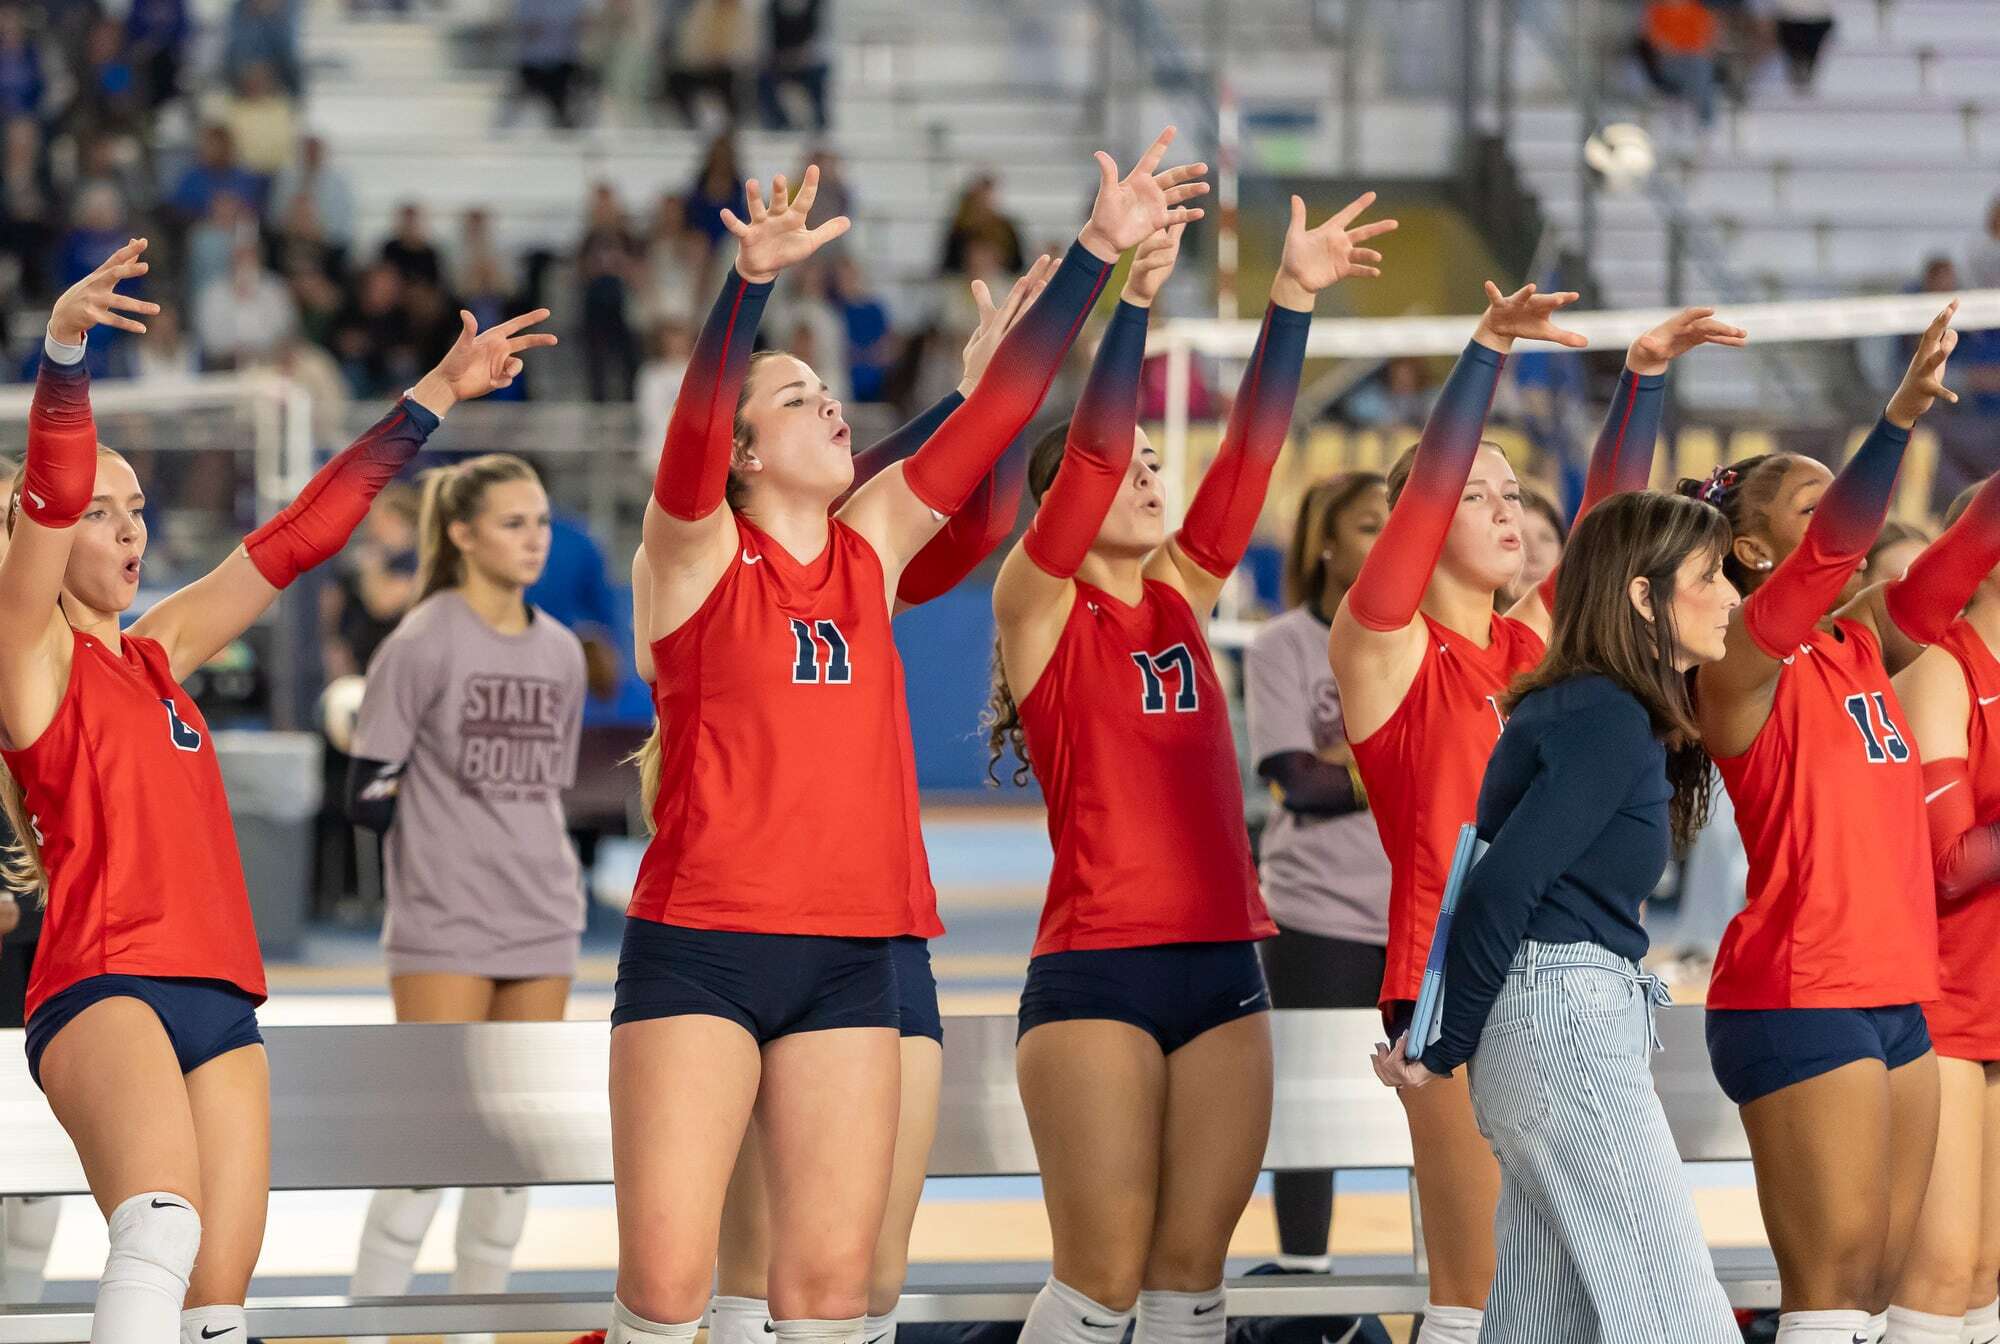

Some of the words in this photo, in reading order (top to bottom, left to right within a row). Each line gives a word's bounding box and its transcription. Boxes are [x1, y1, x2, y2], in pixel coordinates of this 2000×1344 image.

[788, 617, 852, 685] 11
[1130, 642, 1199, 714] 17
[465, 678, 558, 723] STATE
